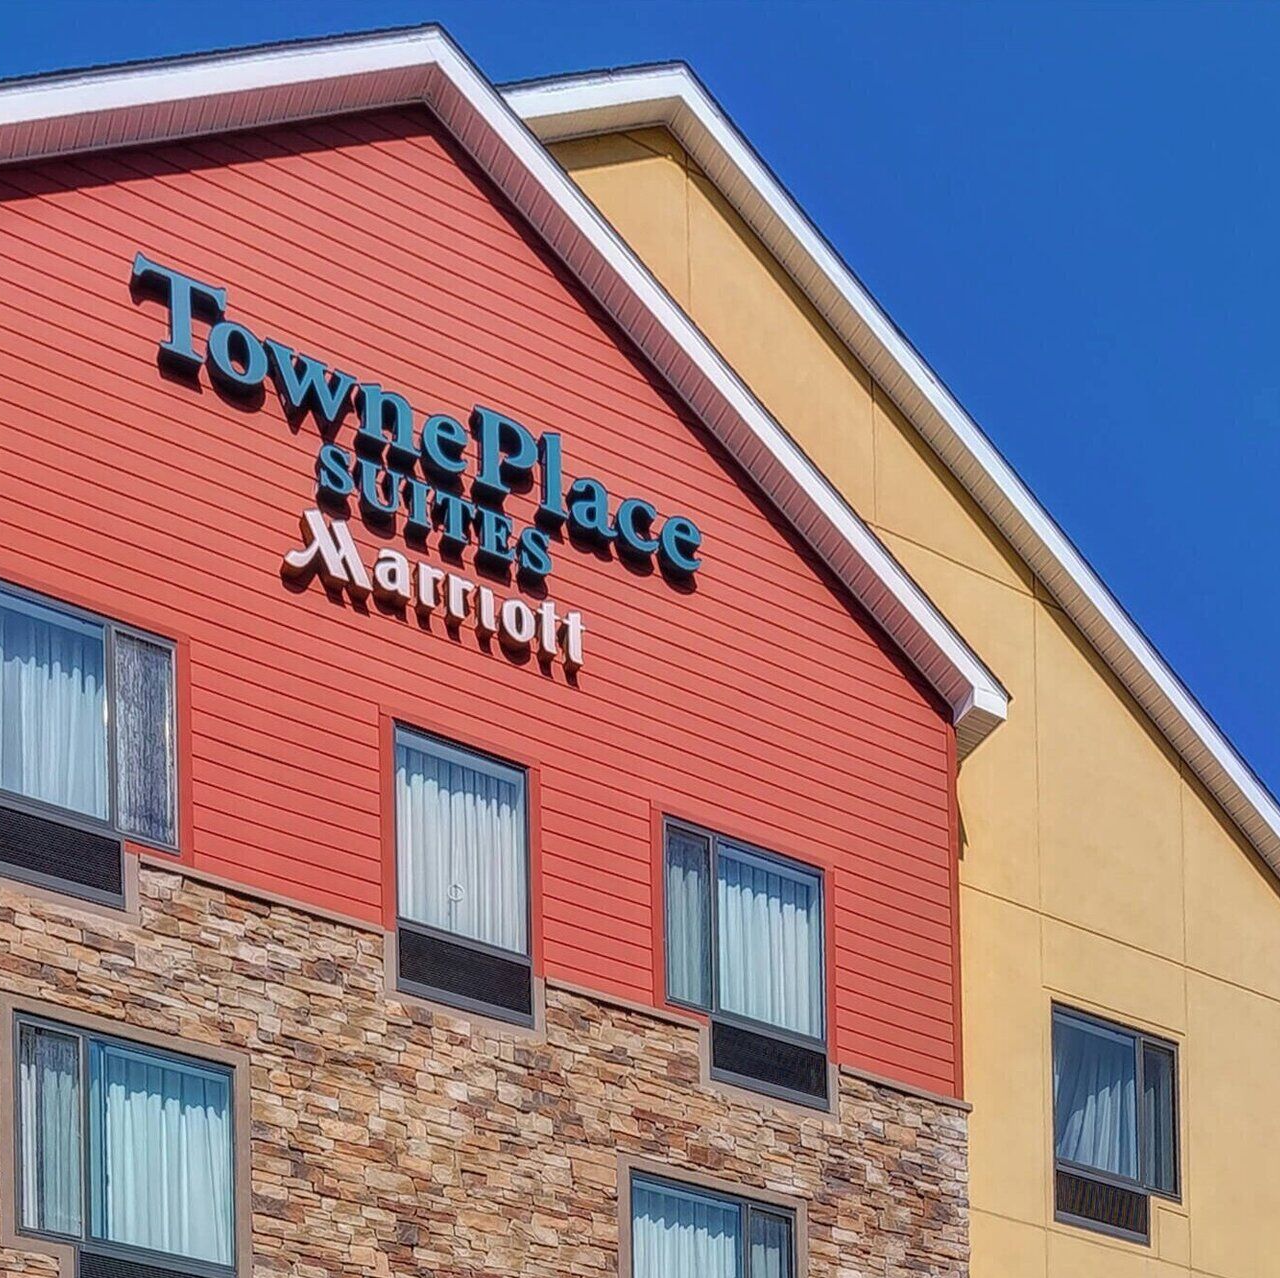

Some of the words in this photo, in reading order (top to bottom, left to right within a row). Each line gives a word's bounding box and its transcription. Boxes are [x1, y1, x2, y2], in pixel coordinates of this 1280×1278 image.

[132, 252, 703, 572] TownePlace
[282, 508, 586, 667] Marriott
[318, 443, 553, 577] SUITES
